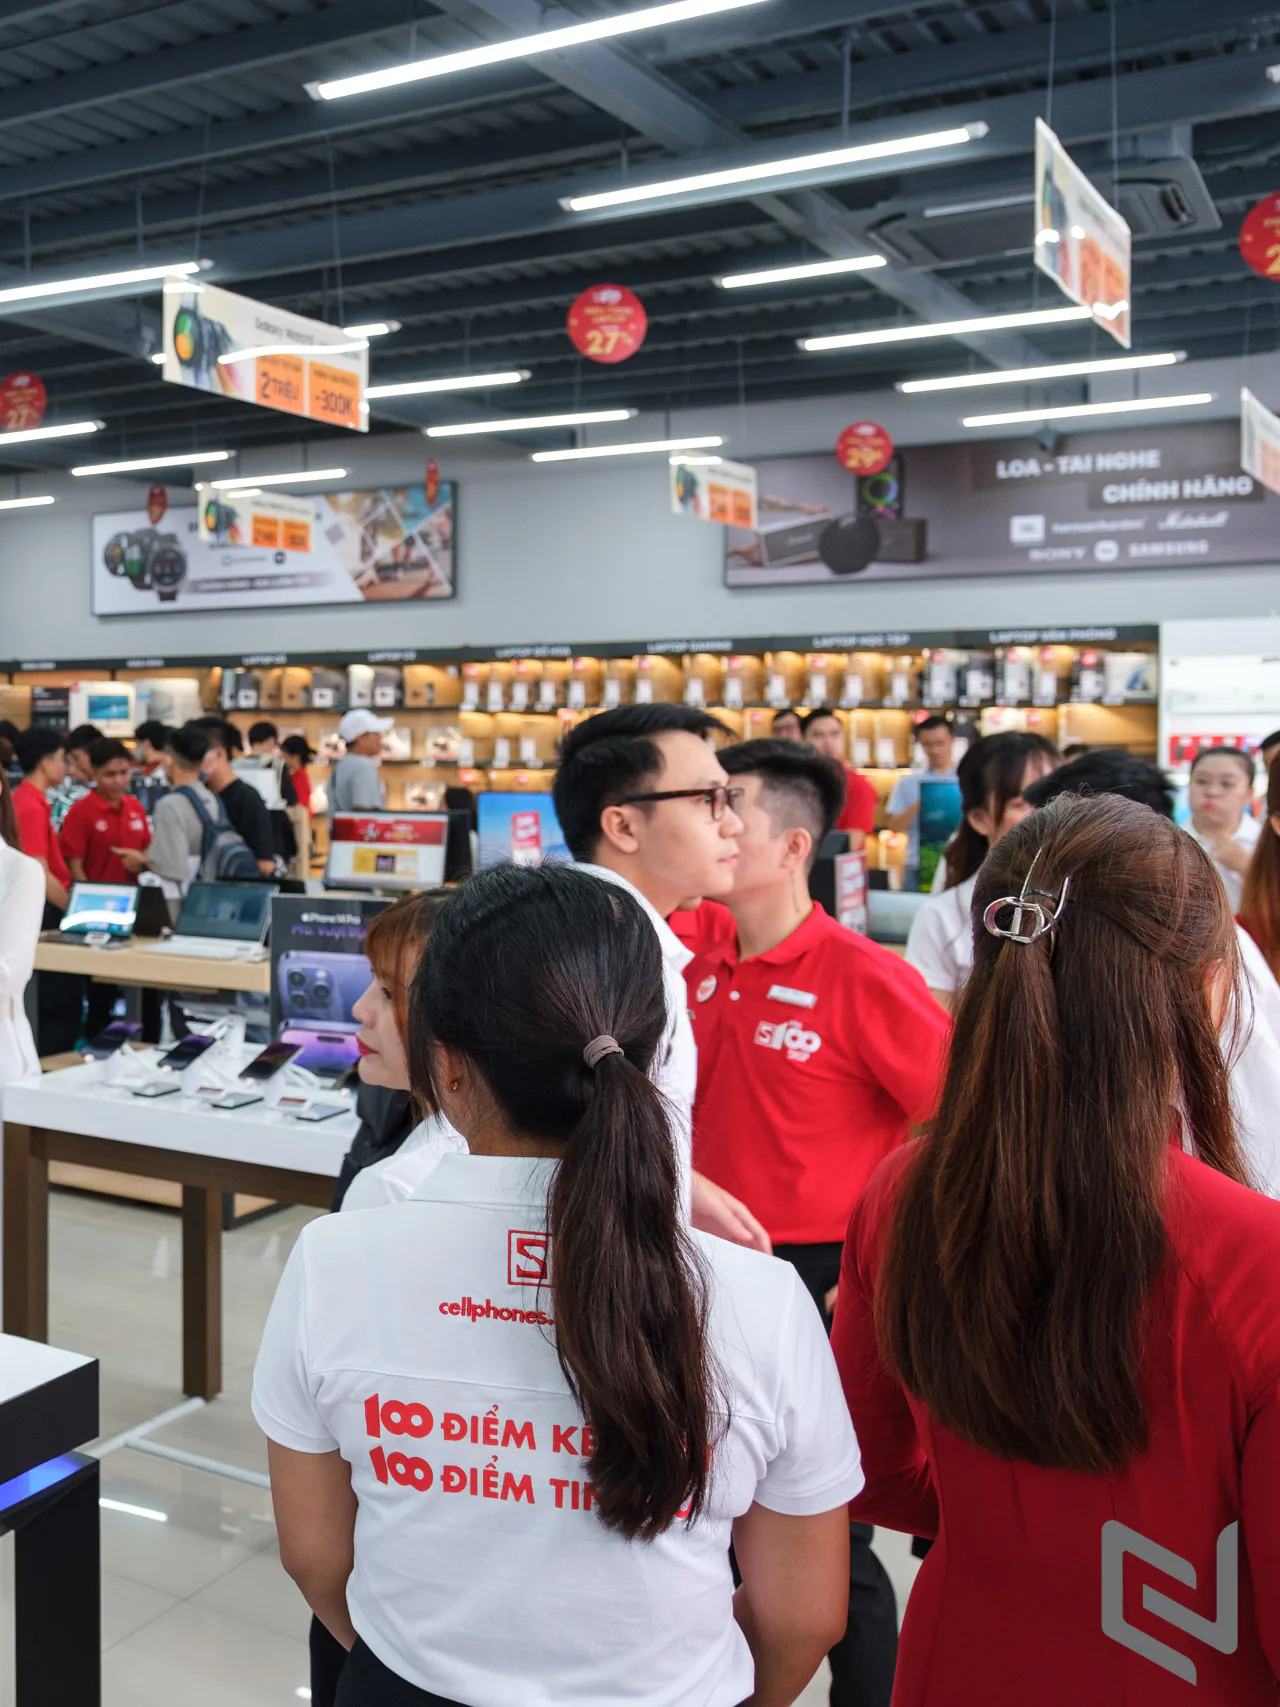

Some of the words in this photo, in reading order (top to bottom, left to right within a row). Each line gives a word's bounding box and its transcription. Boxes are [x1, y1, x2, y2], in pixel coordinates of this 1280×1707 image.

[1266, 244, 1280, 275] 2
[996, 459, 1041, 480] LOA
[1056, 453, 1093, 476] TAI
[1096, 449, 1162, 473] NGHE
[1103, 477, 1179, 504] CHÍNH
[1183, 473, 1255, 499] HÃNG
[438, 1296, 555, 1326] cellphones.
[364, 1392, 434, 1439] 100
[441, 1404, 537, 1451] ĐIỂM
[369, 1445, 434, 1492] 100
[440, 1455, 536, 1505] ĐIỂM
